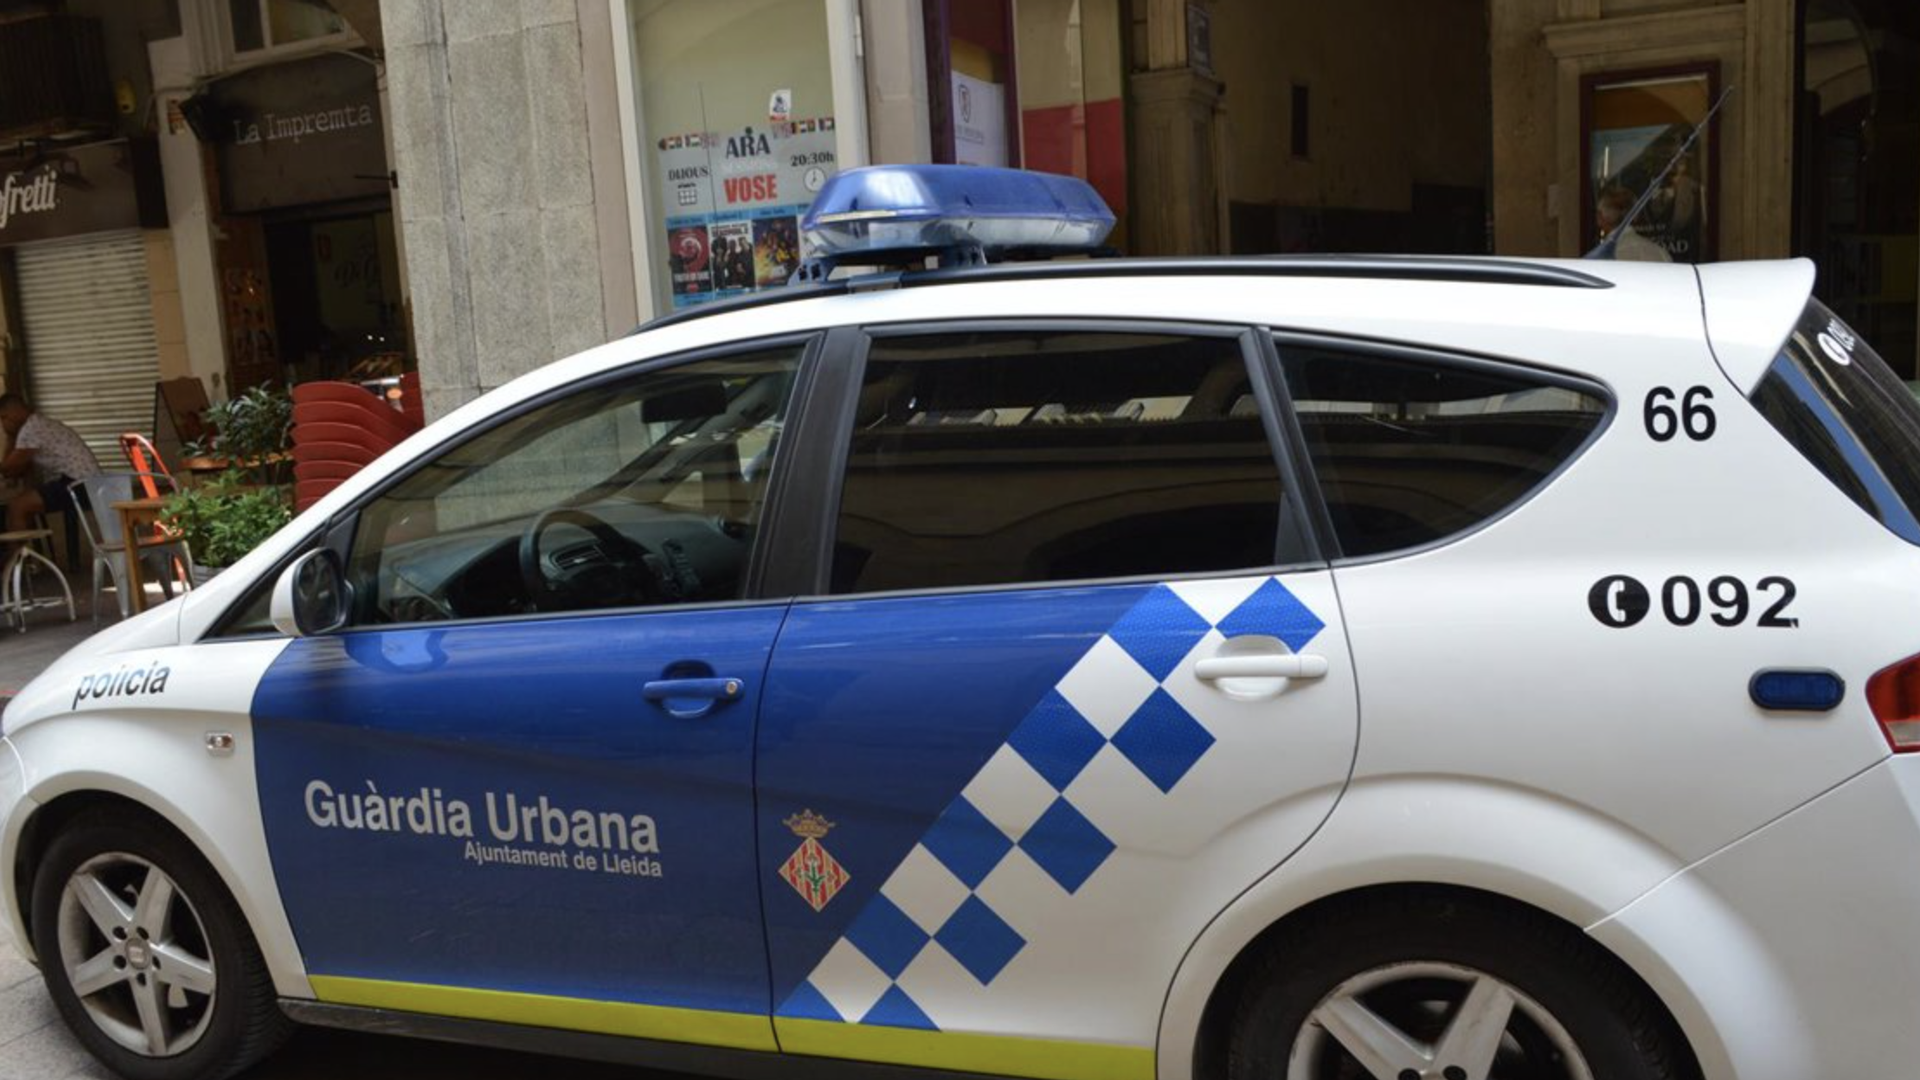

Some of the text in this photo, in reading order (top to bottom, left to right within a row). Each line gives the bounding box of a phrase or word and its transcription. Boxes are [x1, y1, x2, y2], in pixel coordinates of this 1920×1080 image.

[233, 103, 373, 146] La Impremta
[724, 133, 771, 158] ARA
[791, 151, 834, 167] 20:30h
[0, 168, 57, 229] fretti
[724, 174, 778, 204] VOSE
[1643, 385, 1717, 442] 66
[1661, 575, 1799, 628] 092
[304, 780, 660, 853] Guàrdia Urbana
[464, 841, 663, 877] Ajuntament de Lleida
